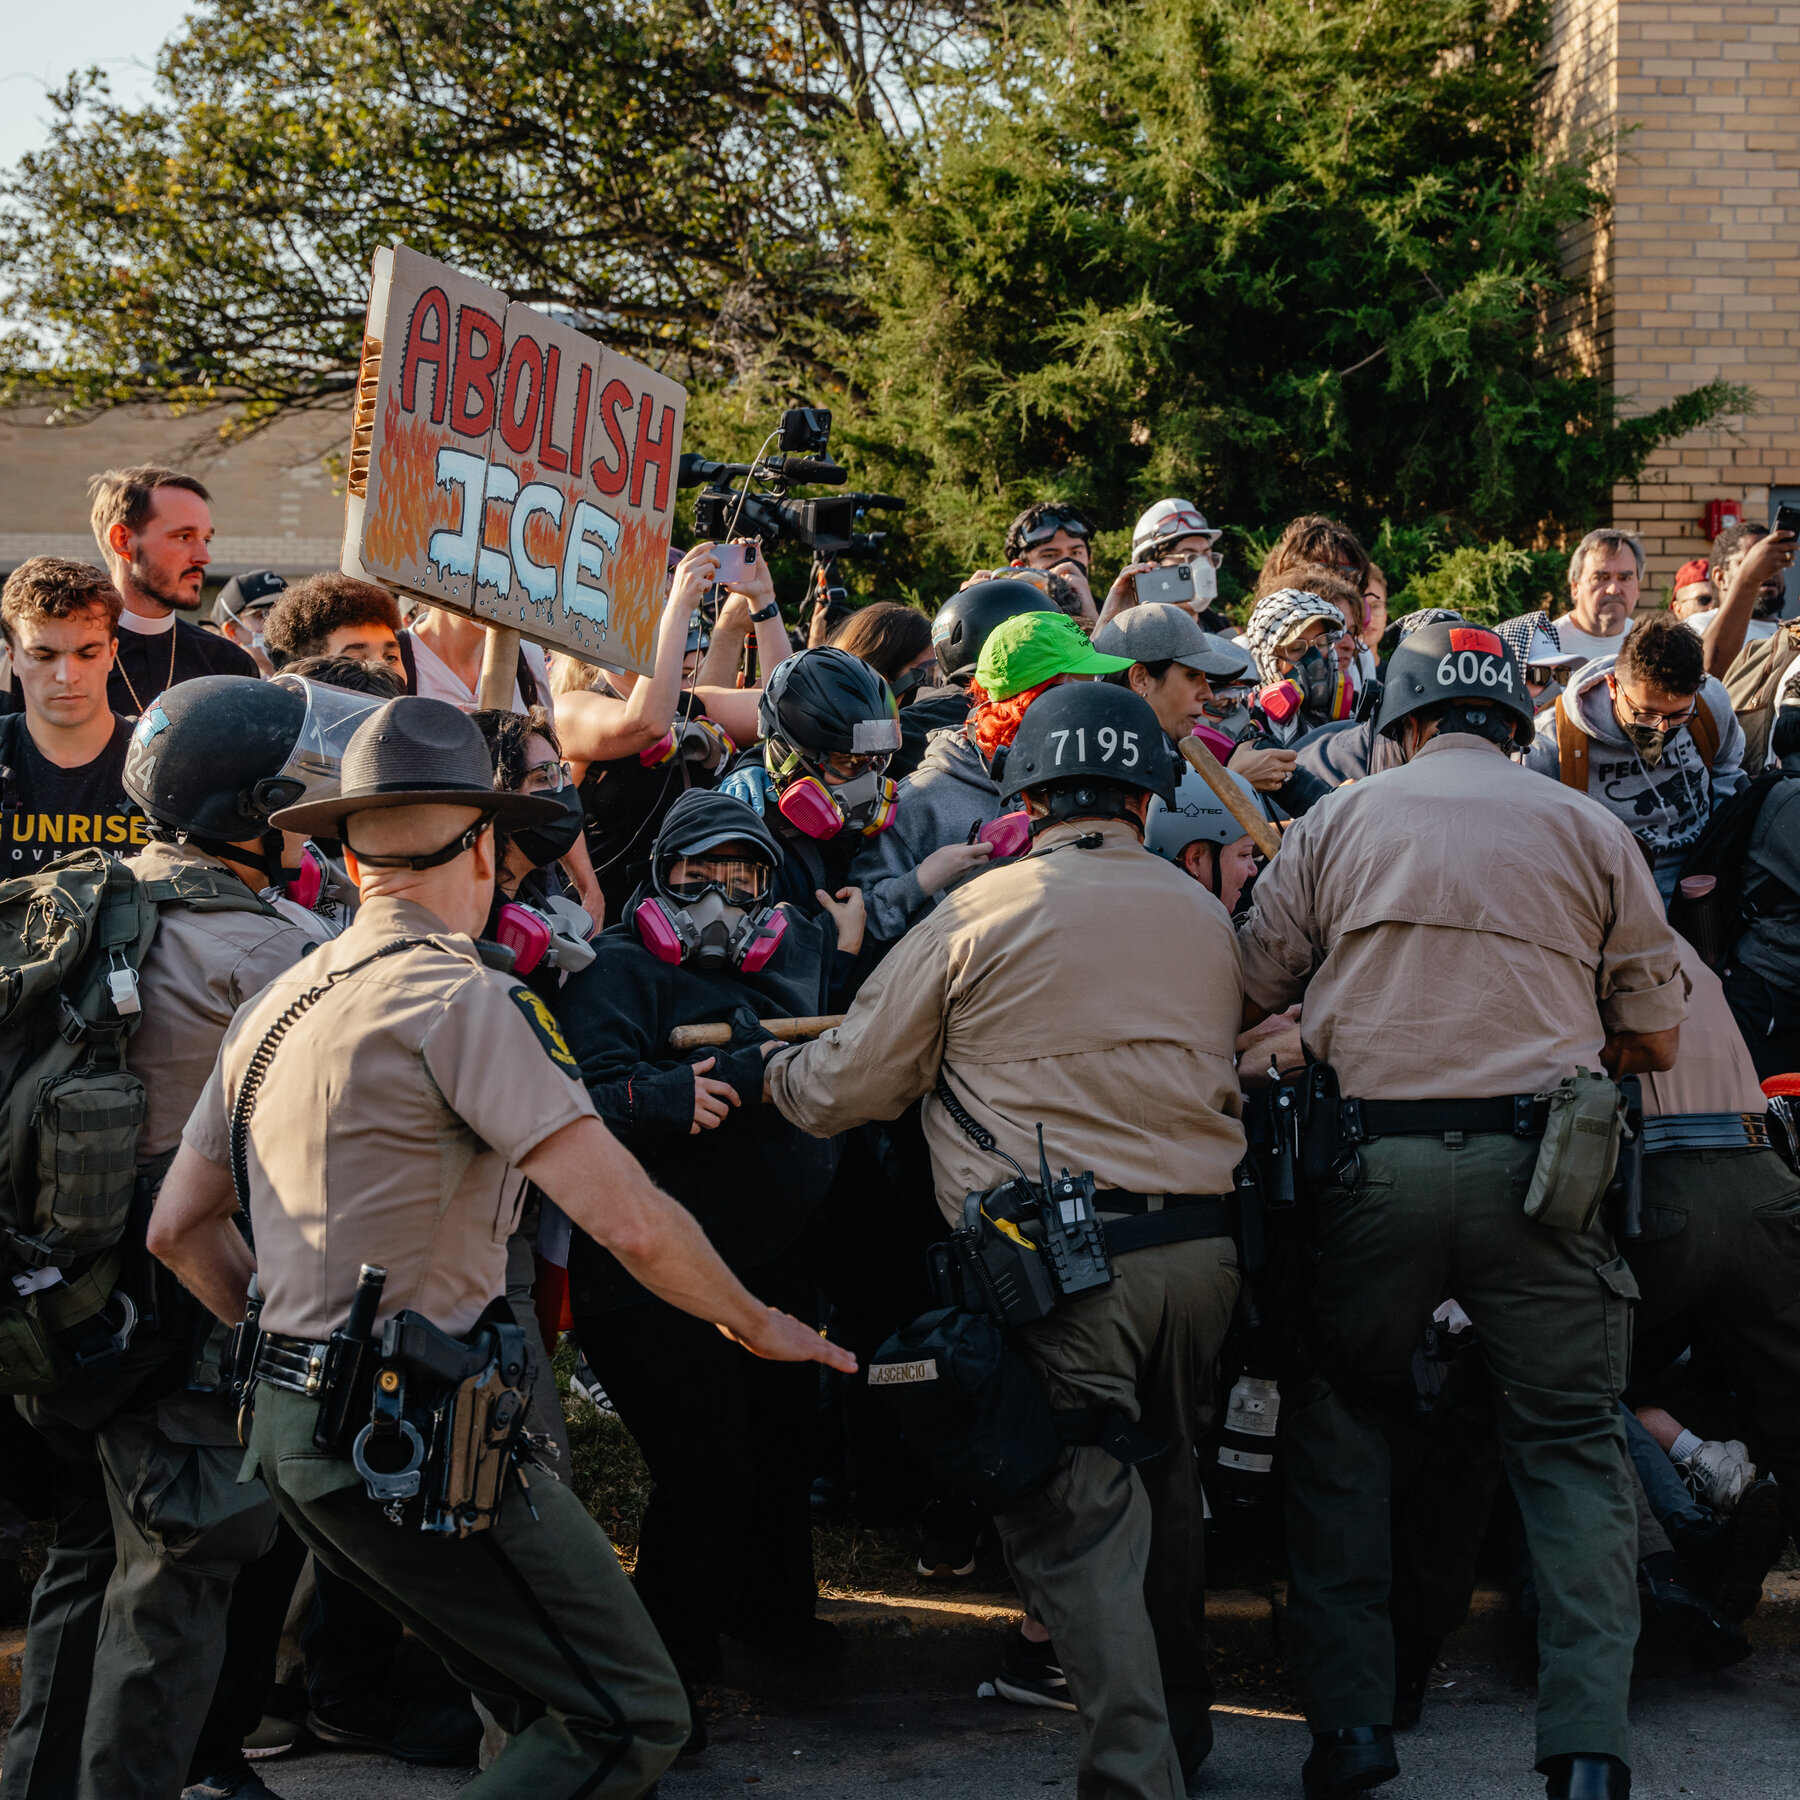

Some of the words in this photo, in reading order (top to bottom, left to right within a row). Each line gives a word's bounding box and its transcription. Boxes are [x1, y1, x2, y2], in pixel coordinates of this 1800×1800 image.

[401, 286, 676, 513] ABOLISH
[428, 446, 620, 629] ICE
[1437, 651, 1513, 693] 6064
[126, 739, 157, 792] 24
[1051, 727, 1139, 767] 7195
[0, 812, 149, 845] UNRISE
[12, 848, 142, 860] OVEN
[877, 1364, 925, 1382] ASCENCIO
